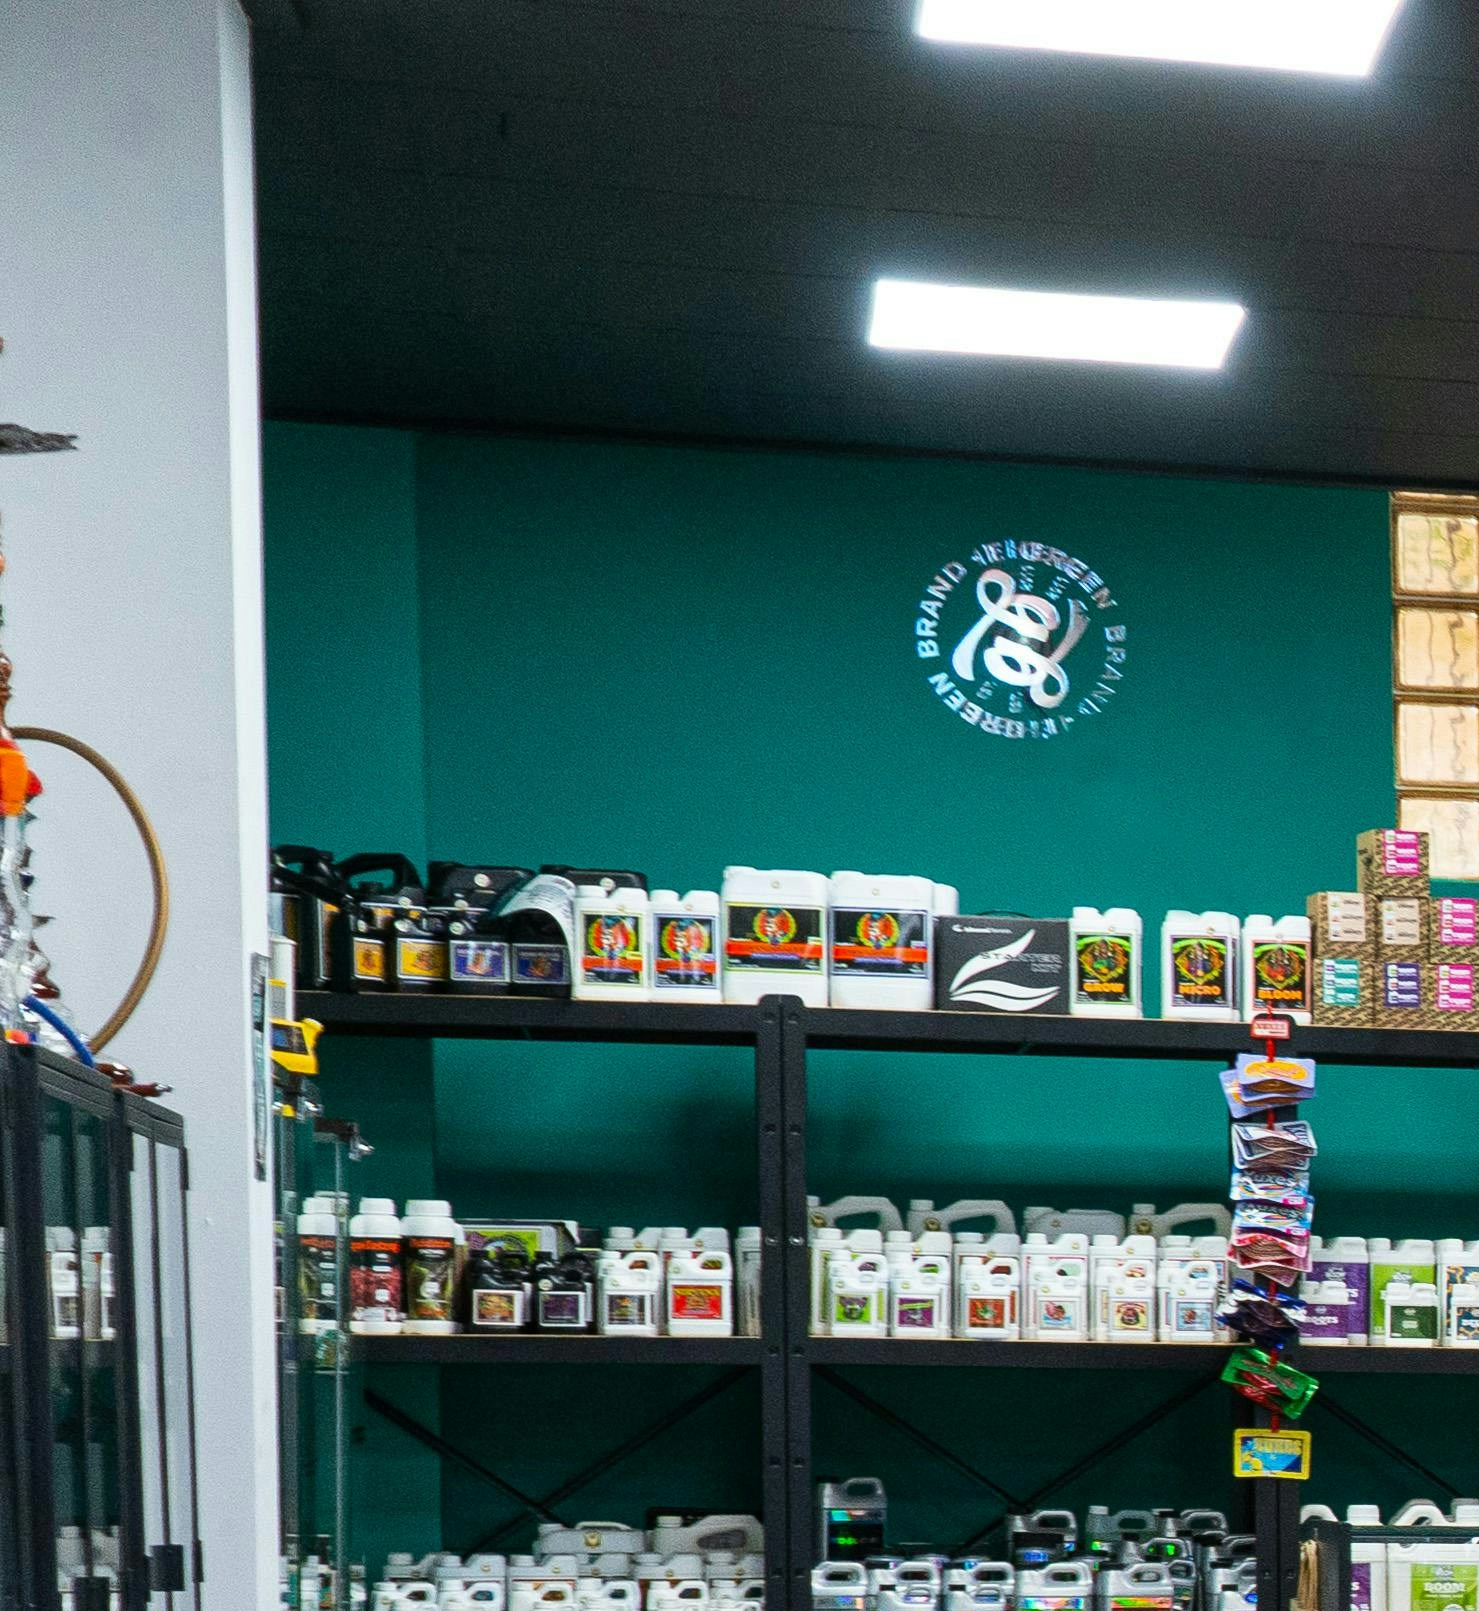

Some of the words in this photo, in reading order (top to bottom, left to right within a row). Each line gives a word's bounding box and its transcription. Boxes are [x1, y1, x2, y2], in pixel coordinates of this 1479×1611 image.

[1082, 982, 1125, 993] GROW
[1177, 985, 1222, 996] MICRO
[1423, 1580, 1465, 1592] BOOM
